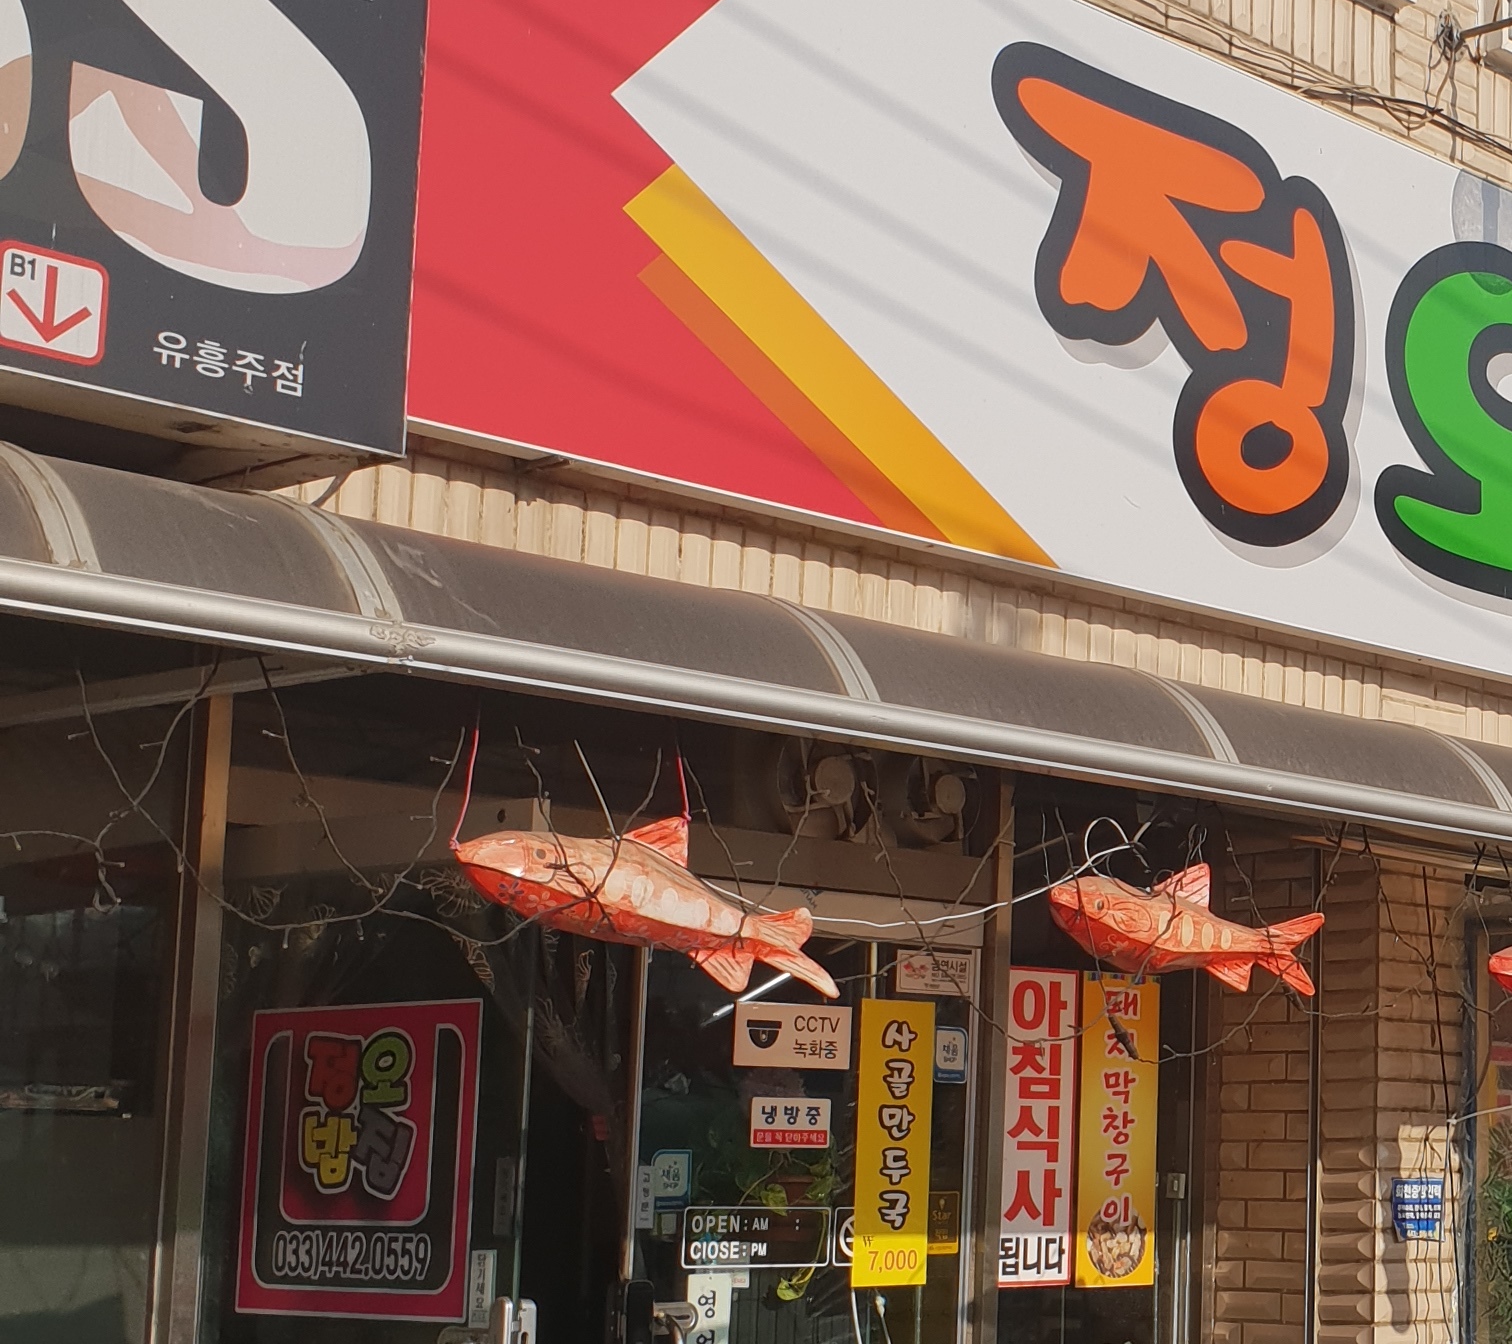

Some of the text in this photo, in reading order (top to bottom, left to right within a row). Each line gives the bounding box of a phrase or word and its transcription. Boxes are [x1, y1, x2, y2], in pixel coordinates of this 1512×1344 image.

[9, 252, 36, 280] B1
[153, 331, 304, 398] 유흥주점
[794, 1015, 840, 1033] CCTV
[793, 1040, 838, 1060] 녹화중
[761, 1104, 821, 1126] 냉방중
[1003, 980, 1067, 1227] 아침식사
[1102, 989, 1141, 1223] 돼지막창구이
[879, 1019, 917, 1230] 사골만두국
[752, 1216, 769, 1231] AM
[272, 1231, 431, 1281] 033)442.0559
[751, 1242, 767, 1256] PM
[868, 1249, 918, 1273] 7,000
[999, 1236, 1065, 1276] 됩니다
